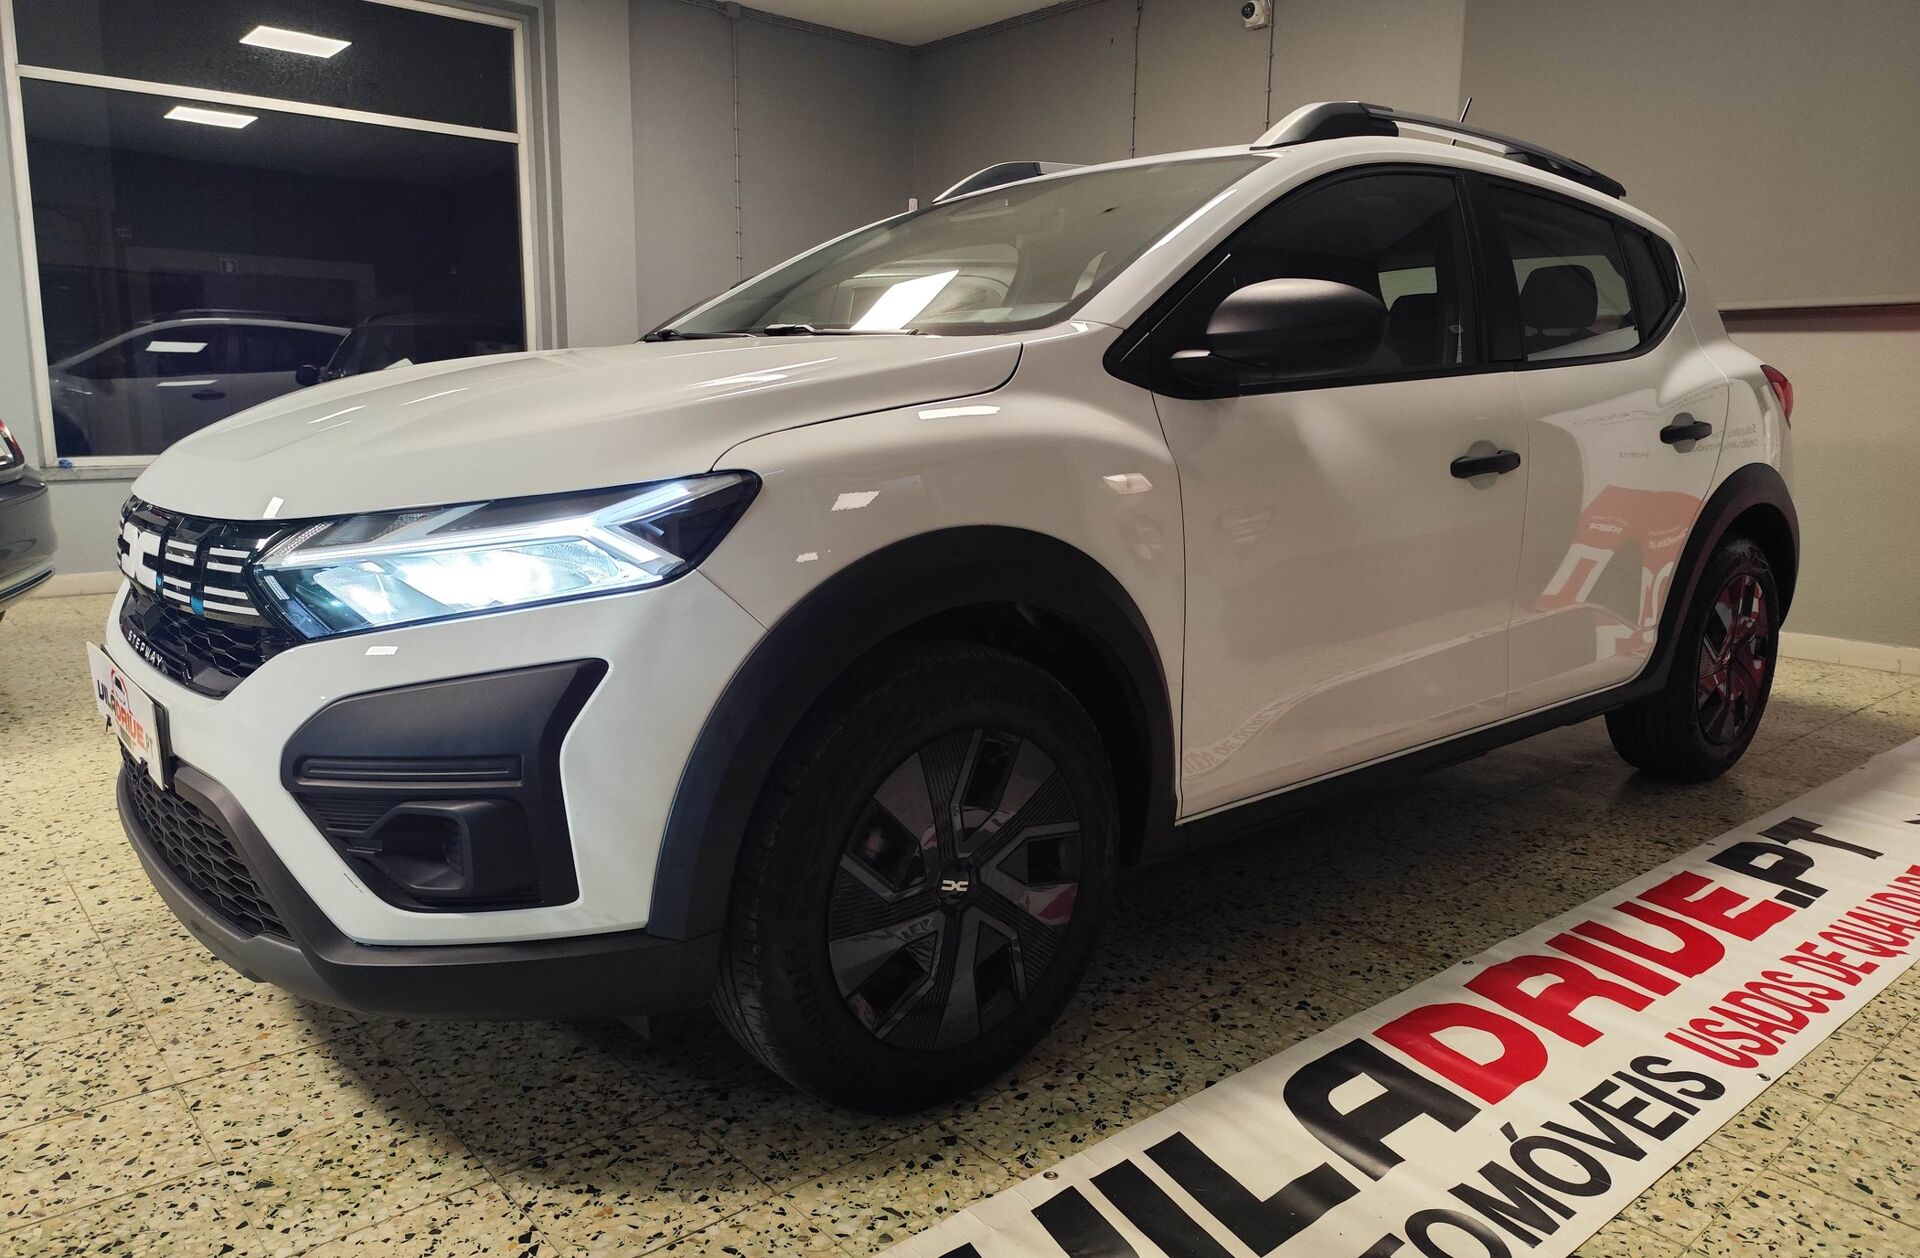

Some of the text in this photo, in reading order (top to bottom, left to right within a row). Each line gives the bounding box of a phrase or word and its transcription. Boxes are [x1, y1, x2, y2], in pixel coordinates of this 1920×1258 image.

[127, 629, 163, 667] STEPWAY
[1357, 864, 1920, 1258] OMÓVEIS USADOS DE QUALID
